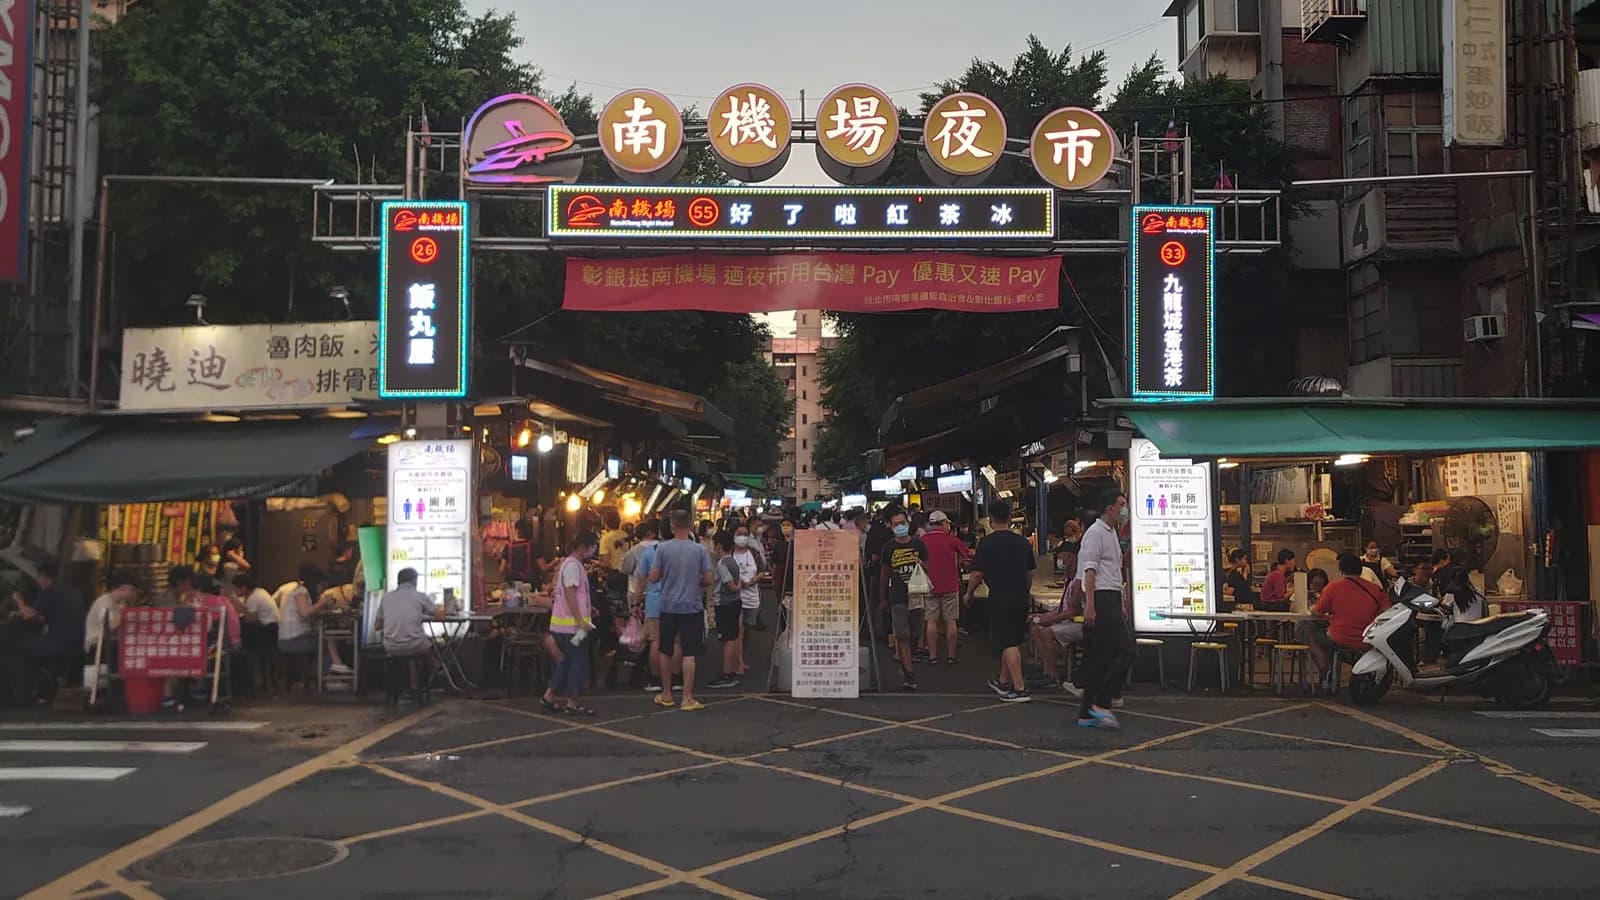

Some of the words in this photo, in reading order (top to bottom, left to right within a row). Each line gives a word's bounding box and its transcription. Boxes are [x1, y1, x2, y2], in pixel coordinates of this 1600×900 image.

[611, 92, 1102, 182] 南機場夜市
[608, 198, 676, 219] 南機場
[694, 205, 713, 220] 55
[729, 202, 1014, 225] 好了啦紅茶冰
[418, 212, 459, 226] 南機場
[1165, 216, 1205, 229] 南機場
[415, 244, 434, 256] 26
[1165, 248, 1182, 259] 33
[581, 263, 717, 288] 彰銀挺南機場
[863, 265, 901, 288] Pay
[912, 261, 1001, 286] 優惠又速
[1008, 265, 1047, 288] Pay
[1163, 273, 1183, 388] 九龍城香港茶
[130, 344, 232, 393] 曉迪
[1170, 493, 1196, 503] 廁所
